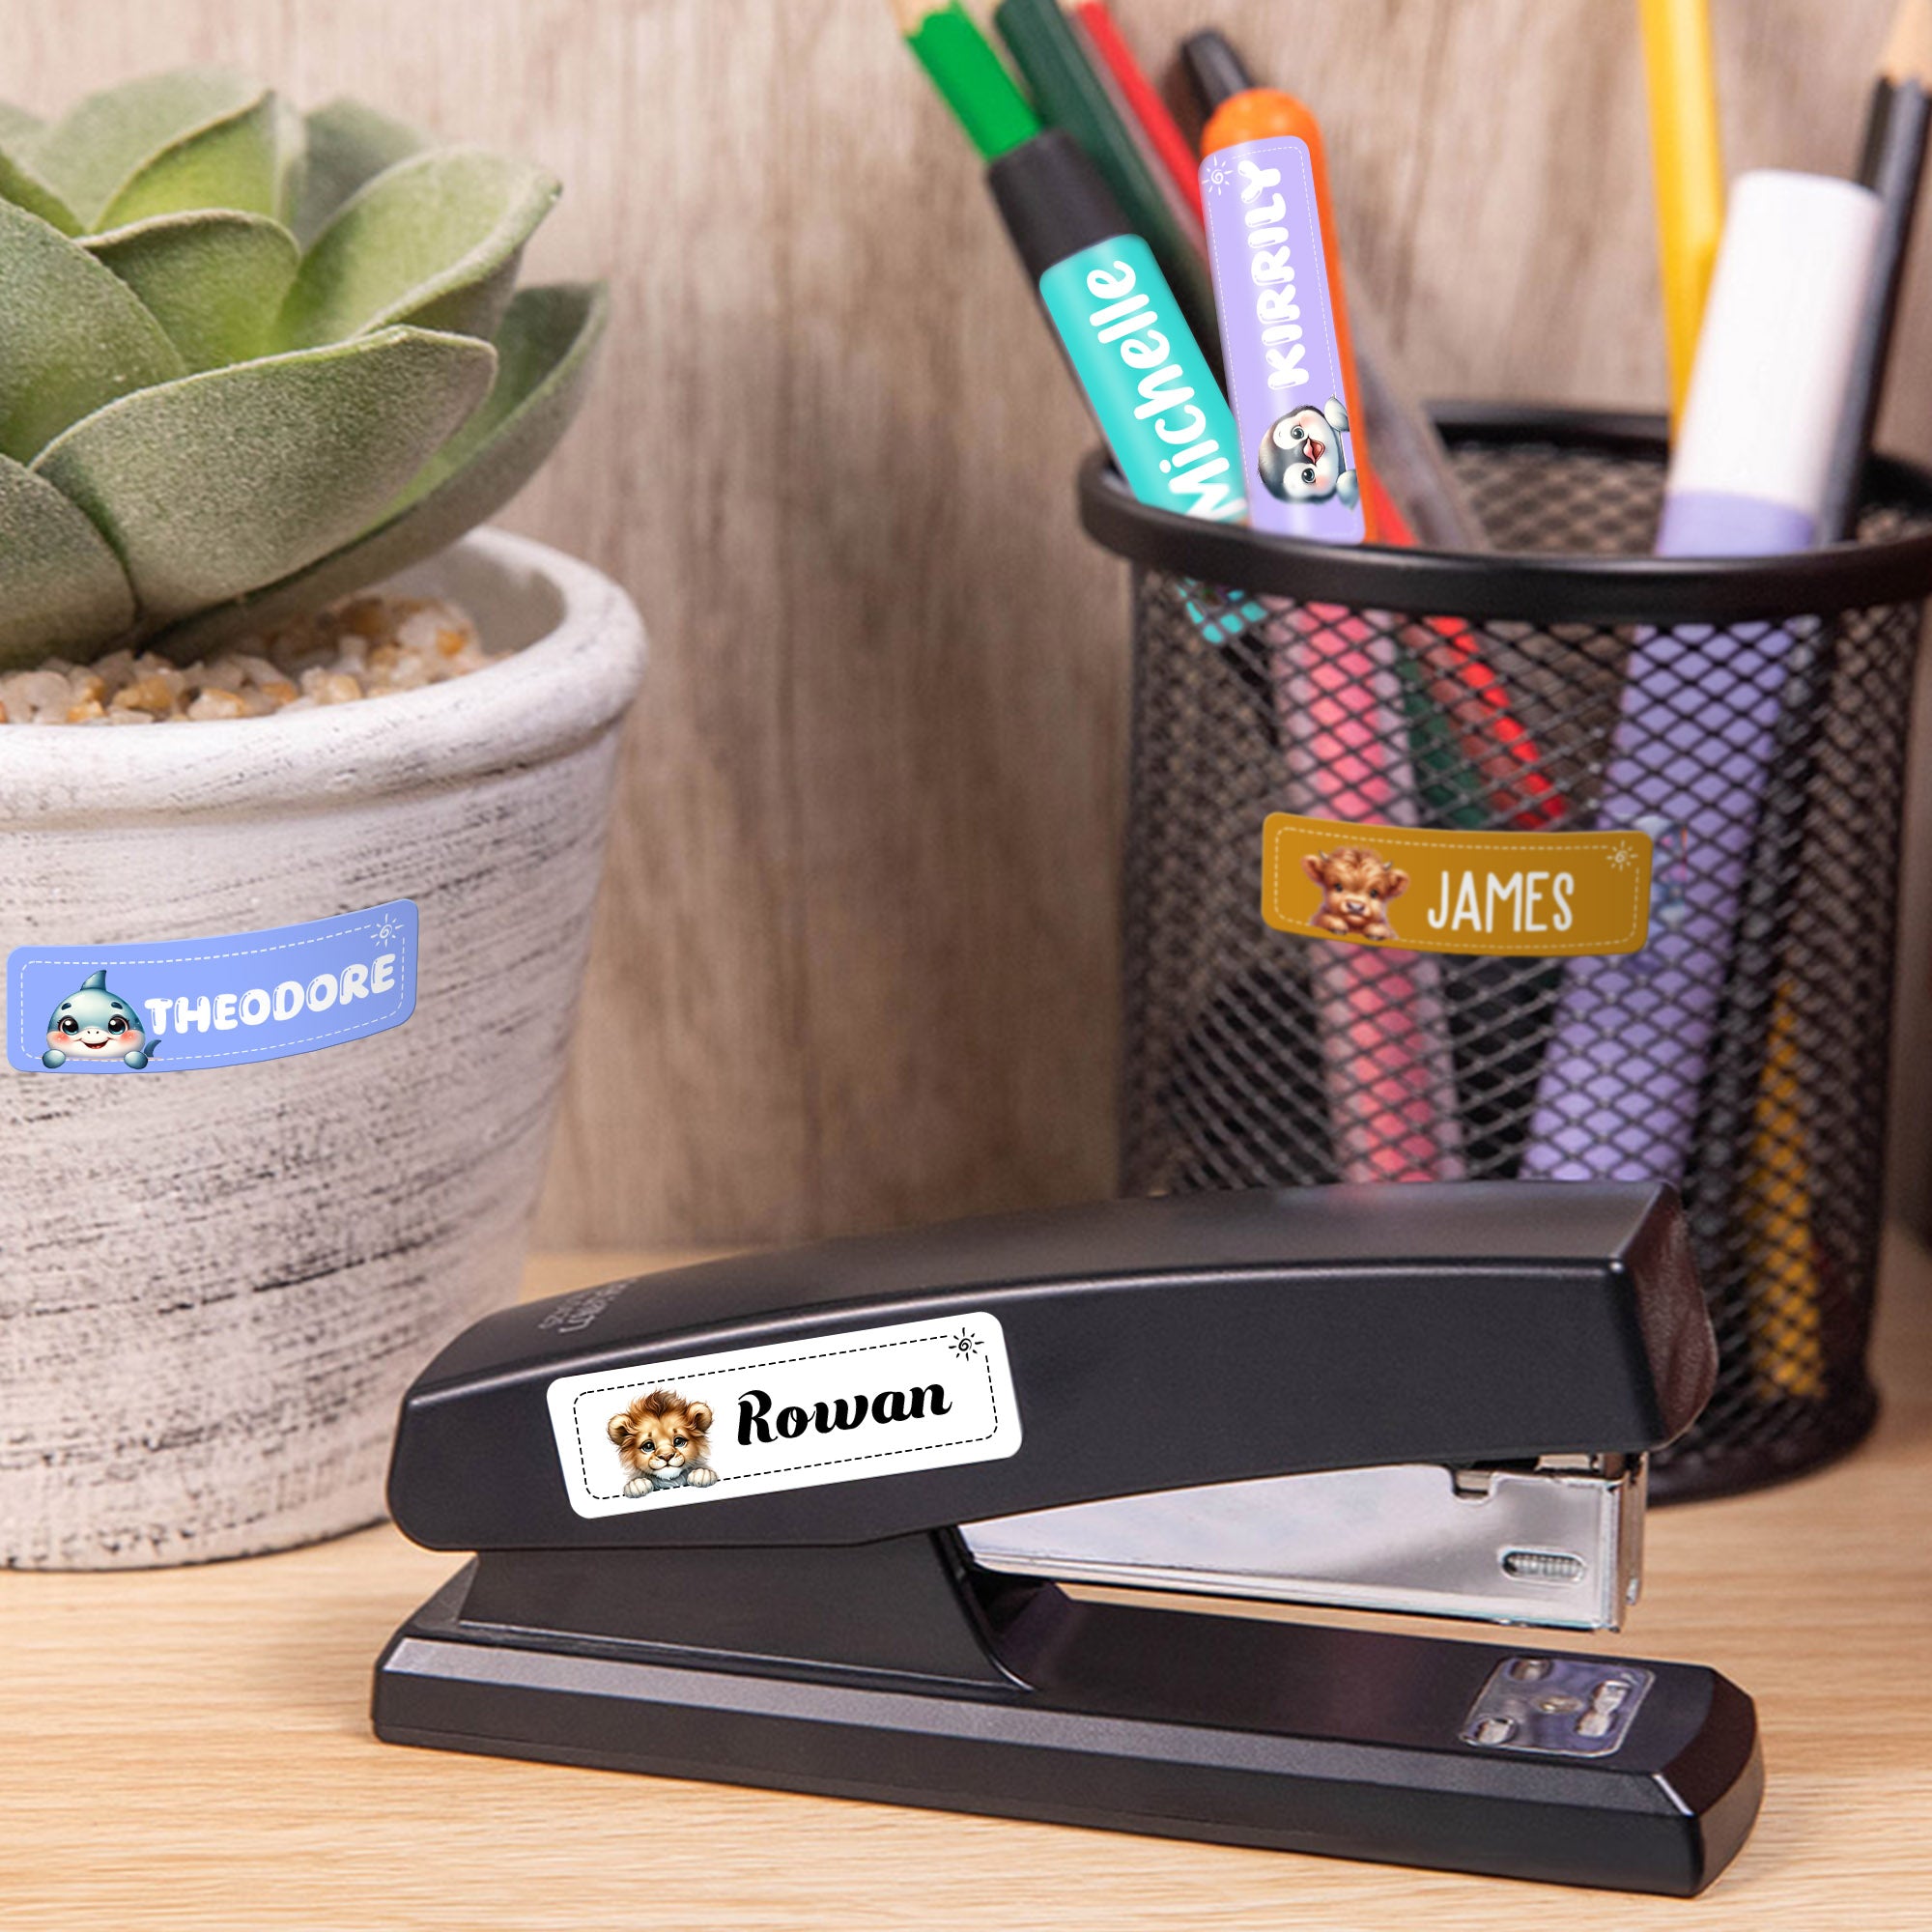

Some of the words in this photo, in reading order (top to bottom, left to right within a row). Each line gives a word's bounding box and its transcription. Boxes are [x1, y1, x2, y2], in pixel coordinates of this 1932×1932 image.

[1237, 159, 1310, 390] KIRRILY
[1087, 259, 1247, 522] Michelle
[1428, 870, 1574, 933] JAMES
[144, 953, 397, 1036] THEODORE
[737, 1383, 952, 1446] Rowan
